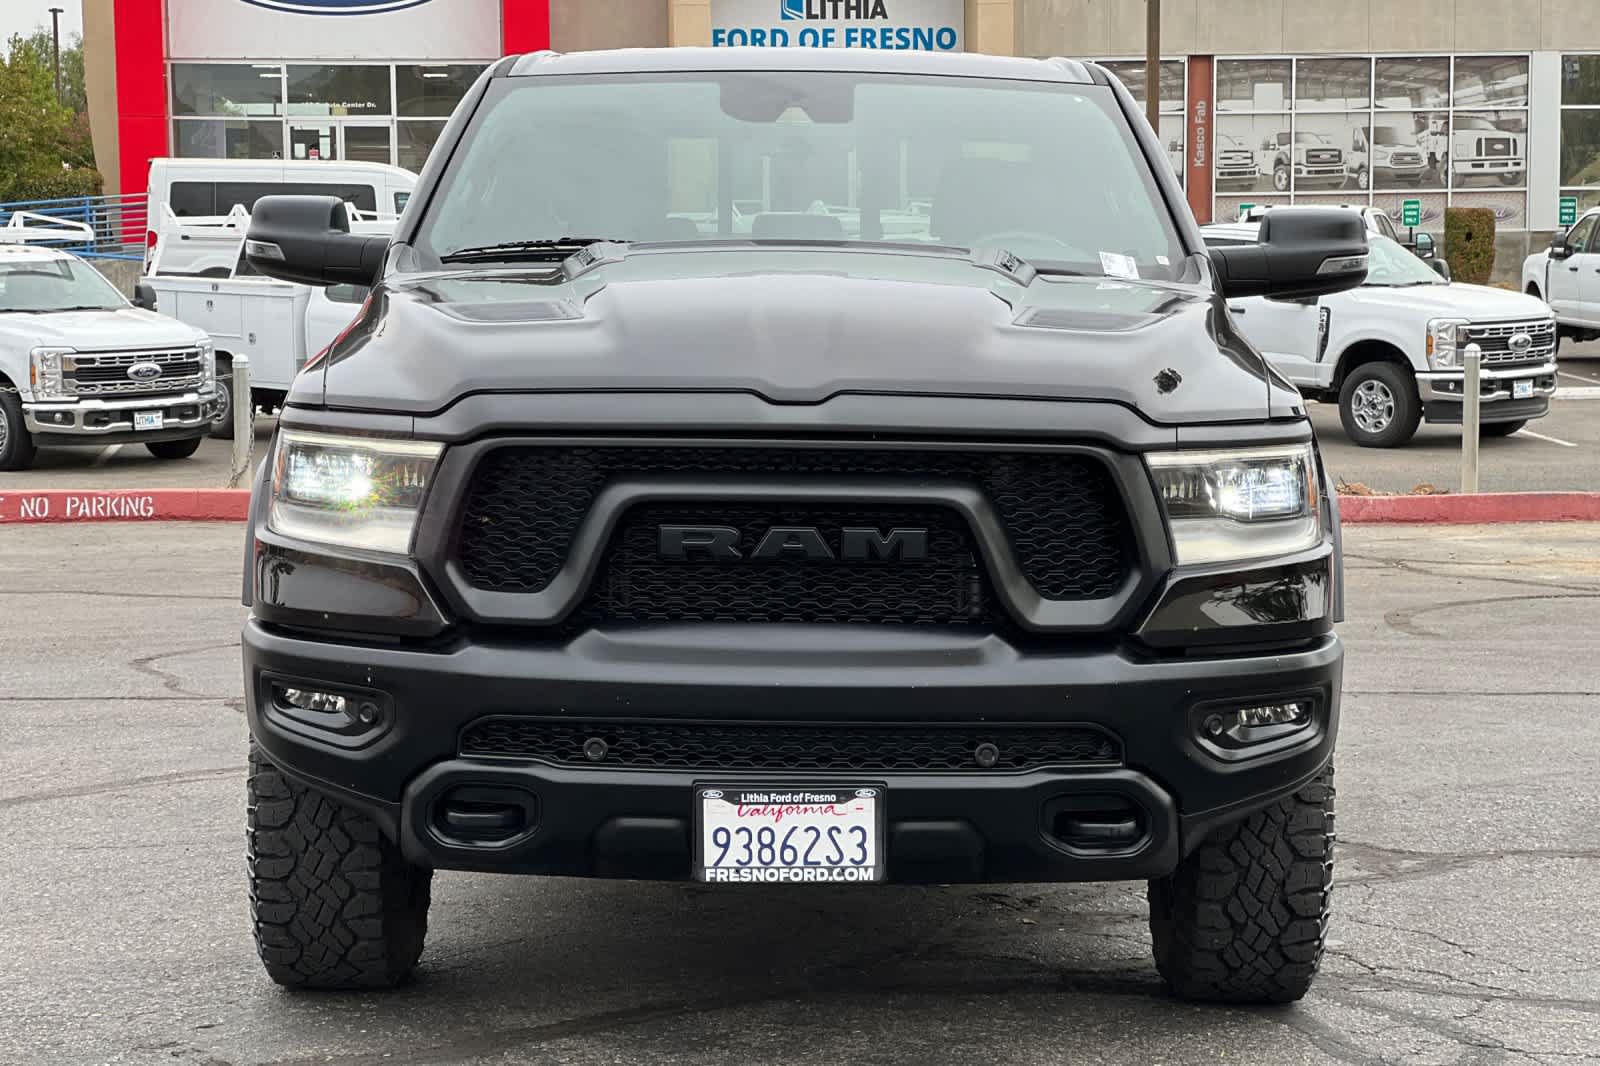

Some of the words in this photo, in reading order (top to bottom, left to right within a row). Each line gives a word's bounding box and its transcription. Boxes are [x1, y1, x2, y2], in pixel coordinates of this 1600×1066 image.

[806, 0, 888, 20] LITHIA
[712, 28, 789, 48] FORD
[799, 28, 835, 48] OF
[845, 27, 957, 51] FRESNO
[1195, 101, 1207, 124] Fab
[1194, 126, 1206, 167] Kasco
[20, 496, 49, 518] NO
[66, 496, 154, 518] PARKING
[657, 523, 928, 561] RAM
[741, 793, 770, 803] Lithia
[770, 793, 794, 803] Ford
[794, 793, 804, 803] of
[804, 793, 837, 803] Fresno
[737, 803, 848, 823] California
[712, 825, 868, 867] 93862S3
[705, 867, 874, 882] FRESNOFORD.COM
